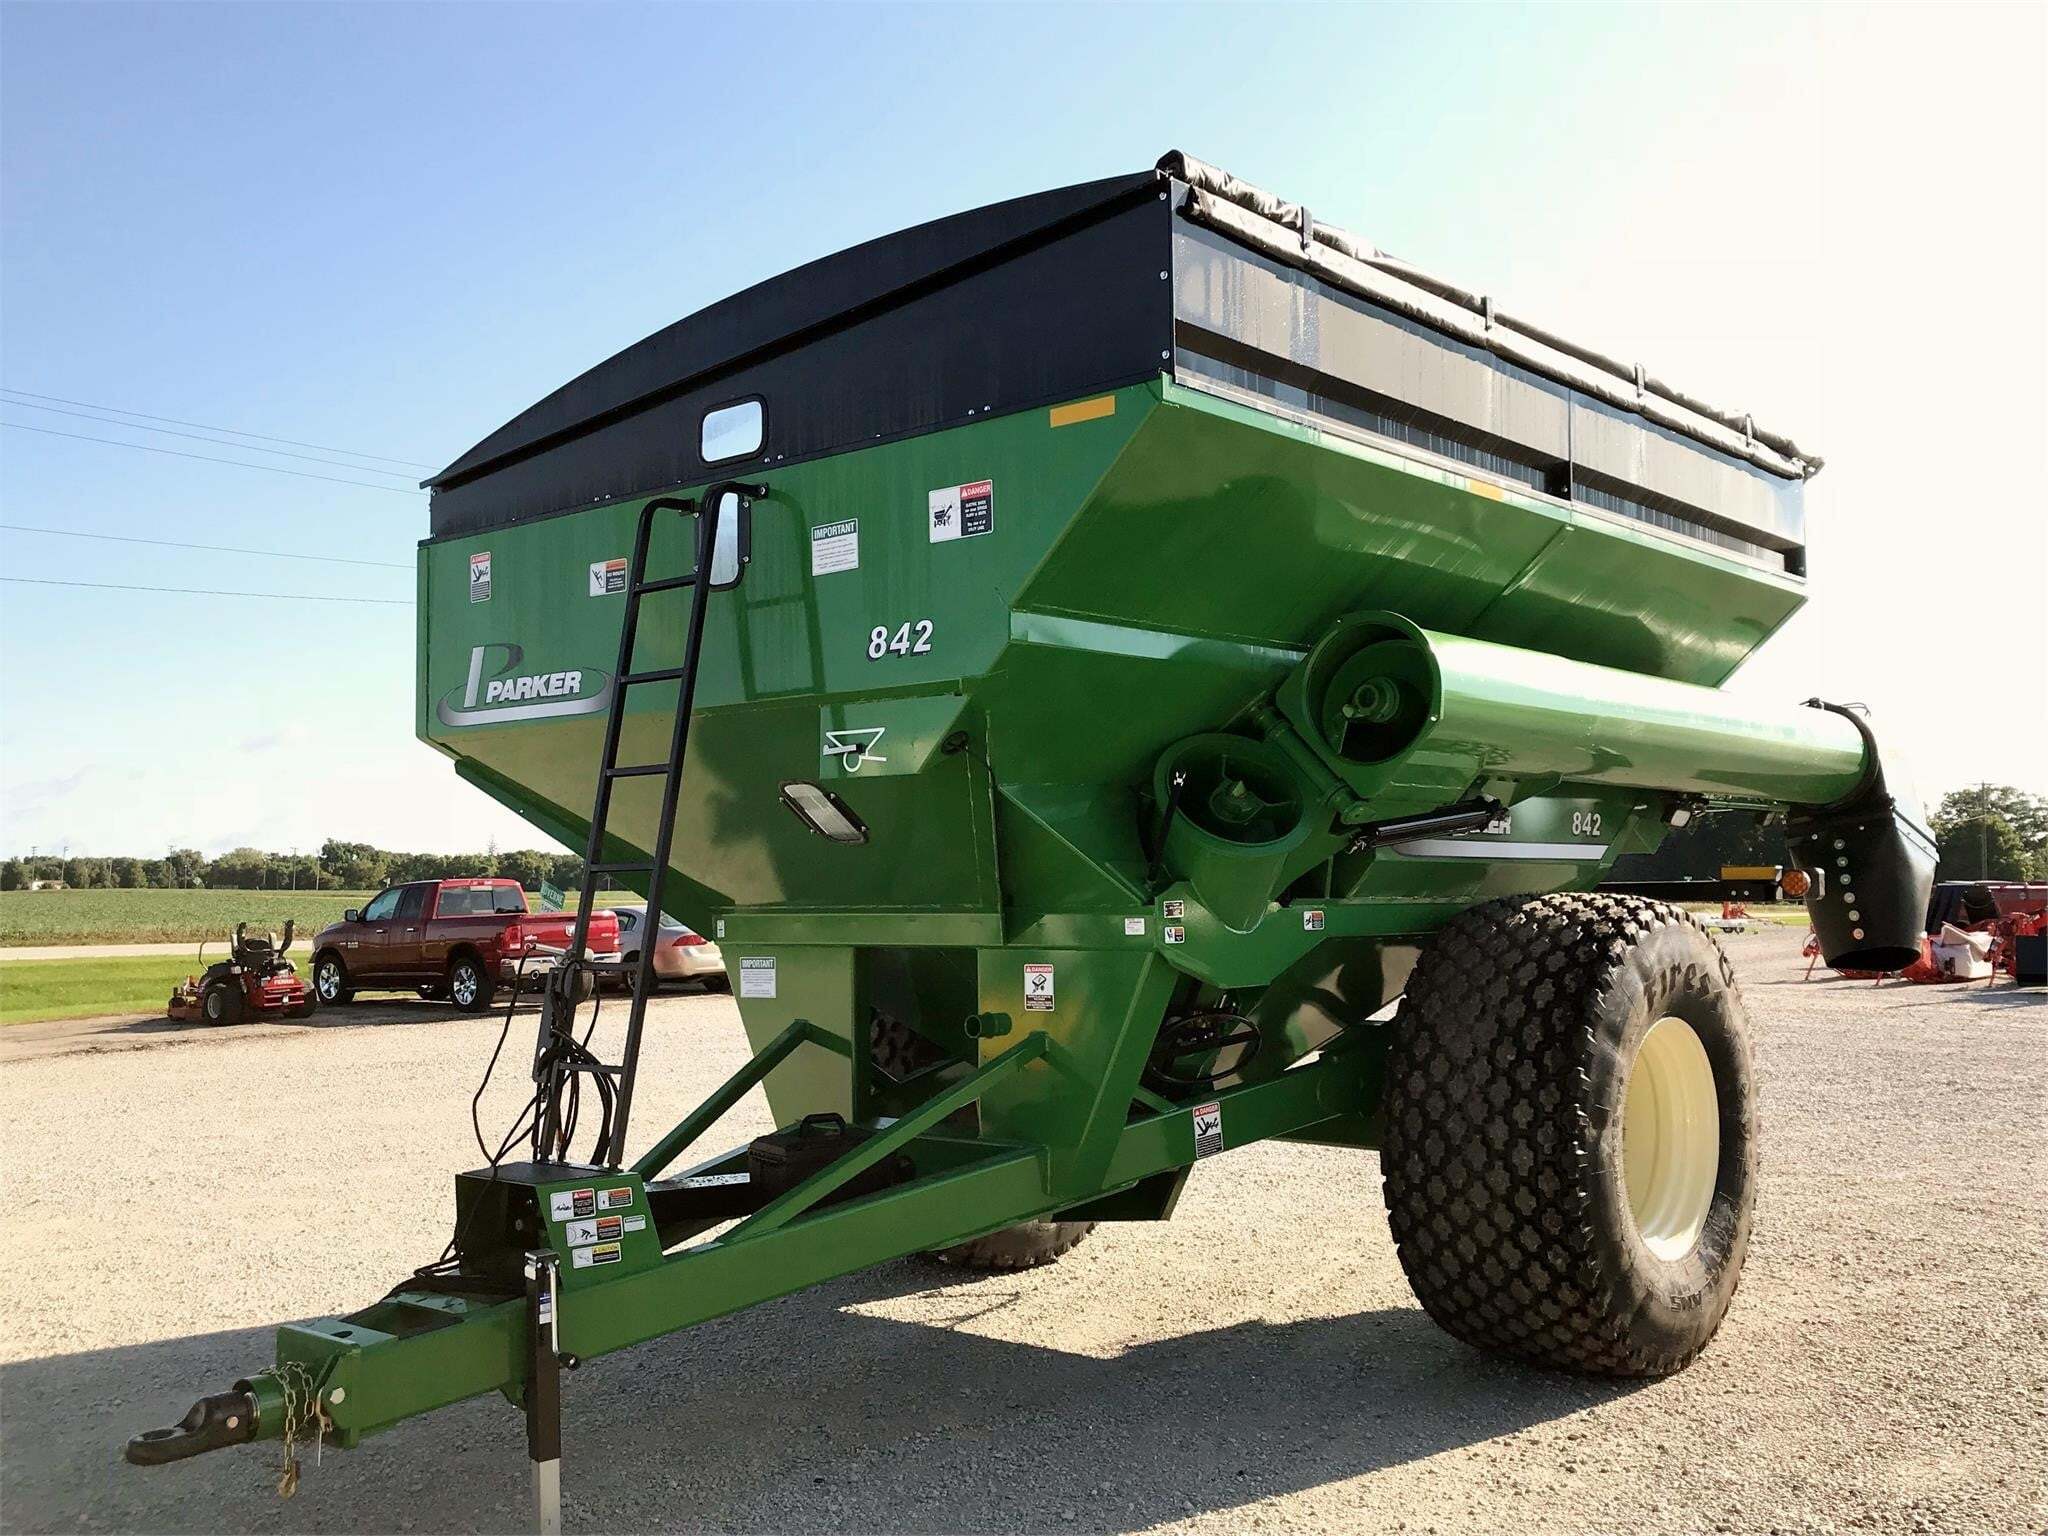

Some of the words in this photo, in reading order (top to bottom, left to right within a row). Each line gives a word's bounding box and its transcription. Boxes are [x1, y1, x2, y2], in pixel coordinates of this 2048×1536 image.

[967, 484, 991, 496] DANGER
[814, 521, 855, 540] IMPORTANT
[868, 619, 934, 660] 842
[485, 670, 582, 704] PARKER
[1572, 811, 1601, 836] 842
[741, 959, 774, 968] IMPORTANT
